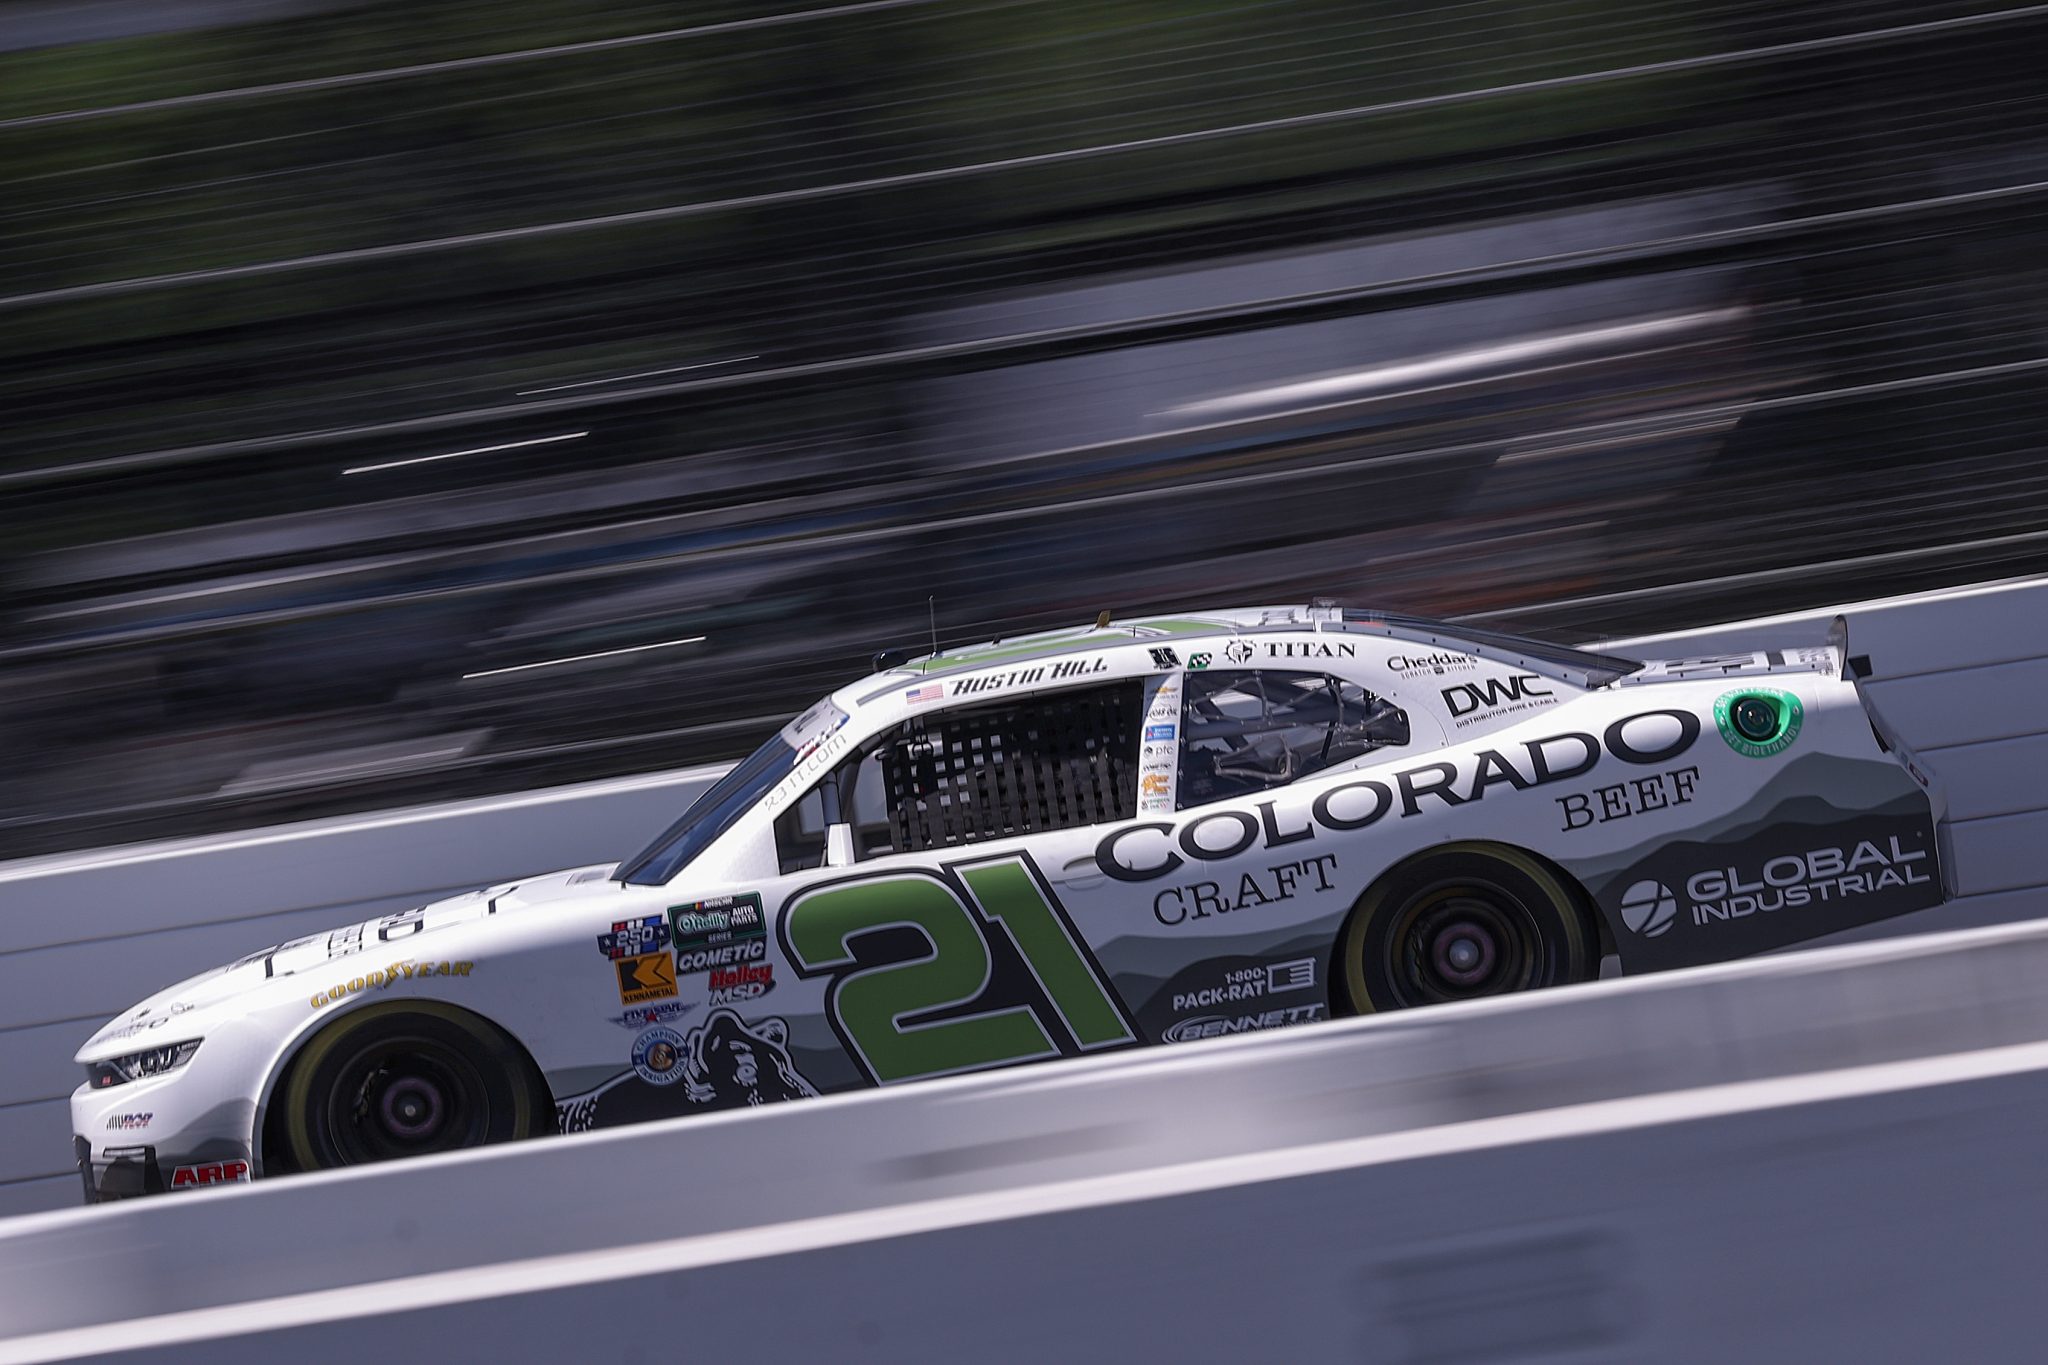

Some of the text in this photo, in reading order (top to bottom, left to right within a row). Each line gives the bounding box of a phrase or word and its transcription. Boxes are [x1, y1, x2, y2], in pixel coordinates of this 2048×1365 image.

[1264, 642, 1356, 658] TITAN
[1387, 653, 1478, 672] Cheddar's
[951, 656, 1108, 697] AUSTIN HILL
[1440, 674, 1554, 718] DWC
[1456, 707, 1508, 729] DISTRIBUTOR
[1508, 703, 1528, 714] WIRE
[1534, 698, 1560, 708] CABLE
[1095, 710, 1701, 881] COLORADO
[1556, 766, 1700, 832] BEEF
[1686, 835, 1927, 900] GLOBAL
[1153, 853, 1338, 926] CRAFT
[1691, 864, 1932, 926] INDUSTRIAL
[731, 912, 758, 927] PARTS
[732, 905, 754, 916] AUTO
[616, 927, 654, 948] 250
[678, 940, 764, 971] COMETIC
[777, 850, 1144, 1087] 21
[310, 959, 475, 1009] GOODYEAR
[709, 963, 773, 988] Holley
[624, 987, 673, 1003] KENNAMETAL
[709, 982, 766, 1007] MSD
[1179, 1002, 1325, 1041] BENNETT
[636, 1029, 681, 1052] CHAMPION
[173, 1161, 248, 1187] ARP
